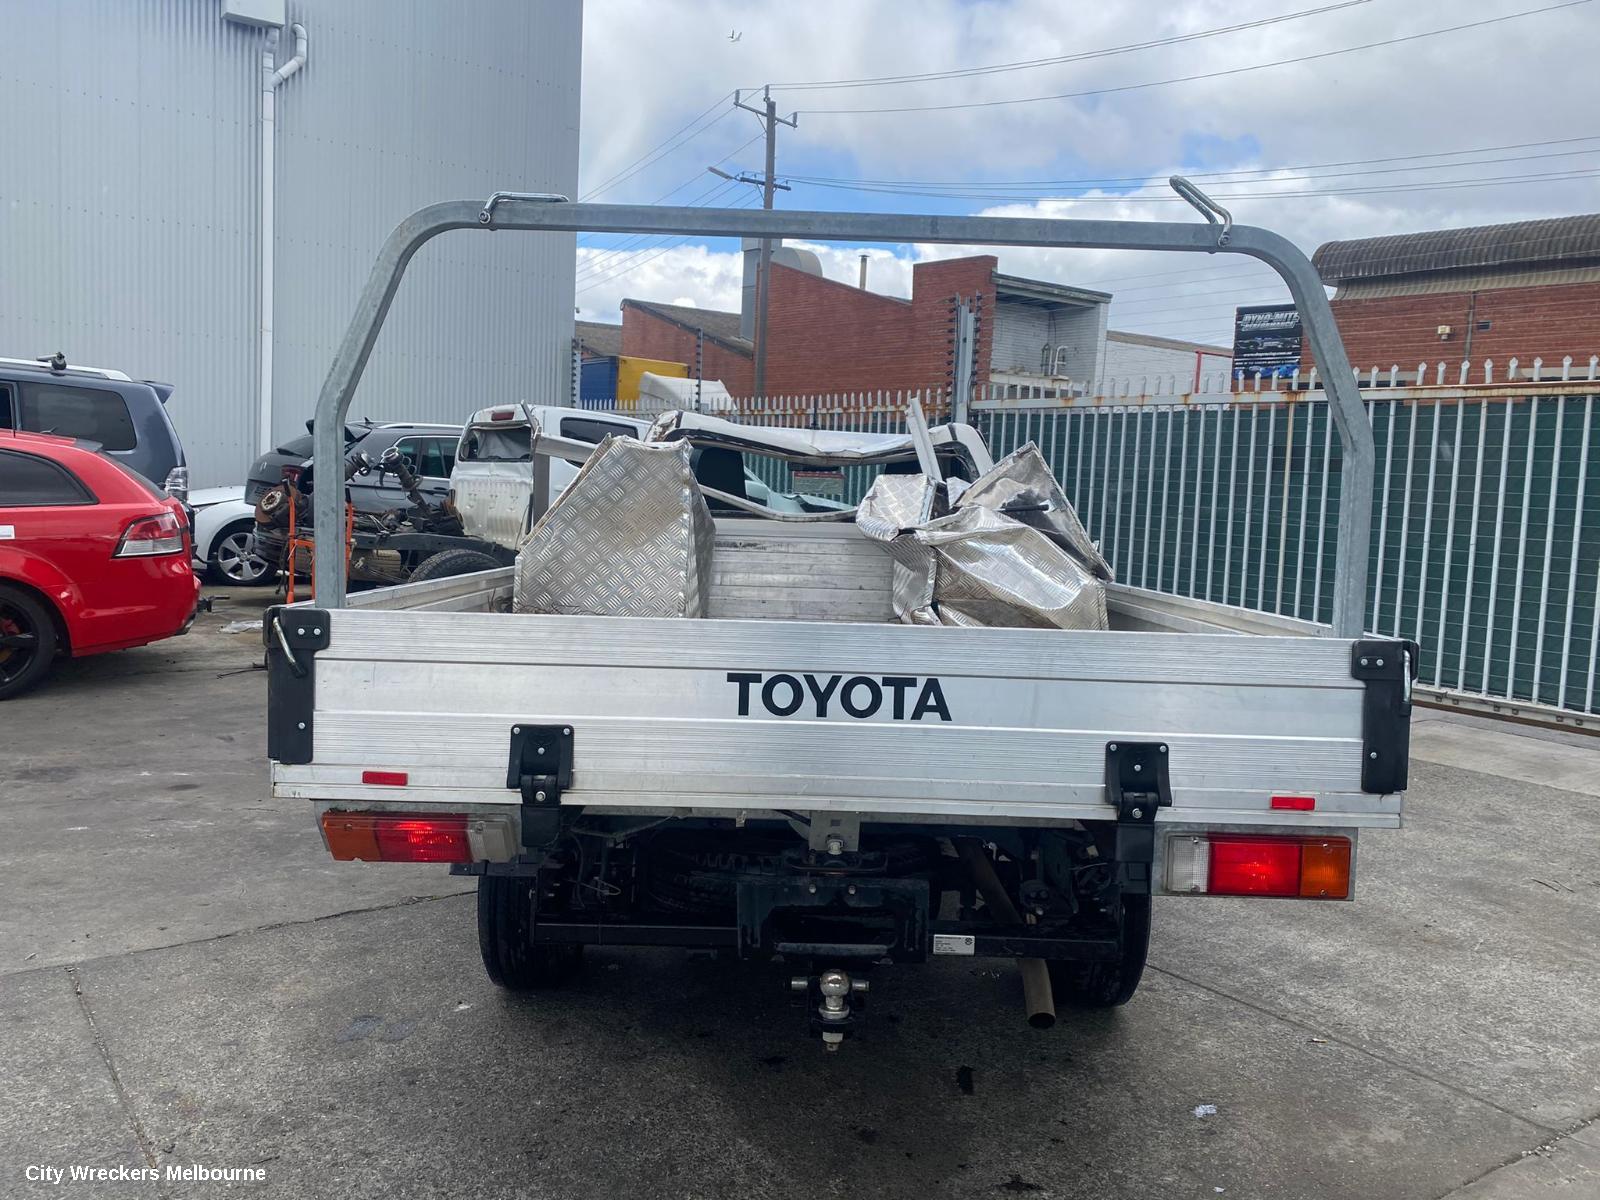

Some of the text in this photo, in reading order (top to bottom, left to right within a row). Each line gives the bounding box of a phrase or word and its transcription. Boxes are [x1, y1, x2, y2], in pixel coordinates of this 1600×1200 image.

[1242, 312, 1299, 324] DYNO-MITE
[1244, 321, 1295, 329] PERFORMANCE
[727, 672, 952, 721] TOYOTA
